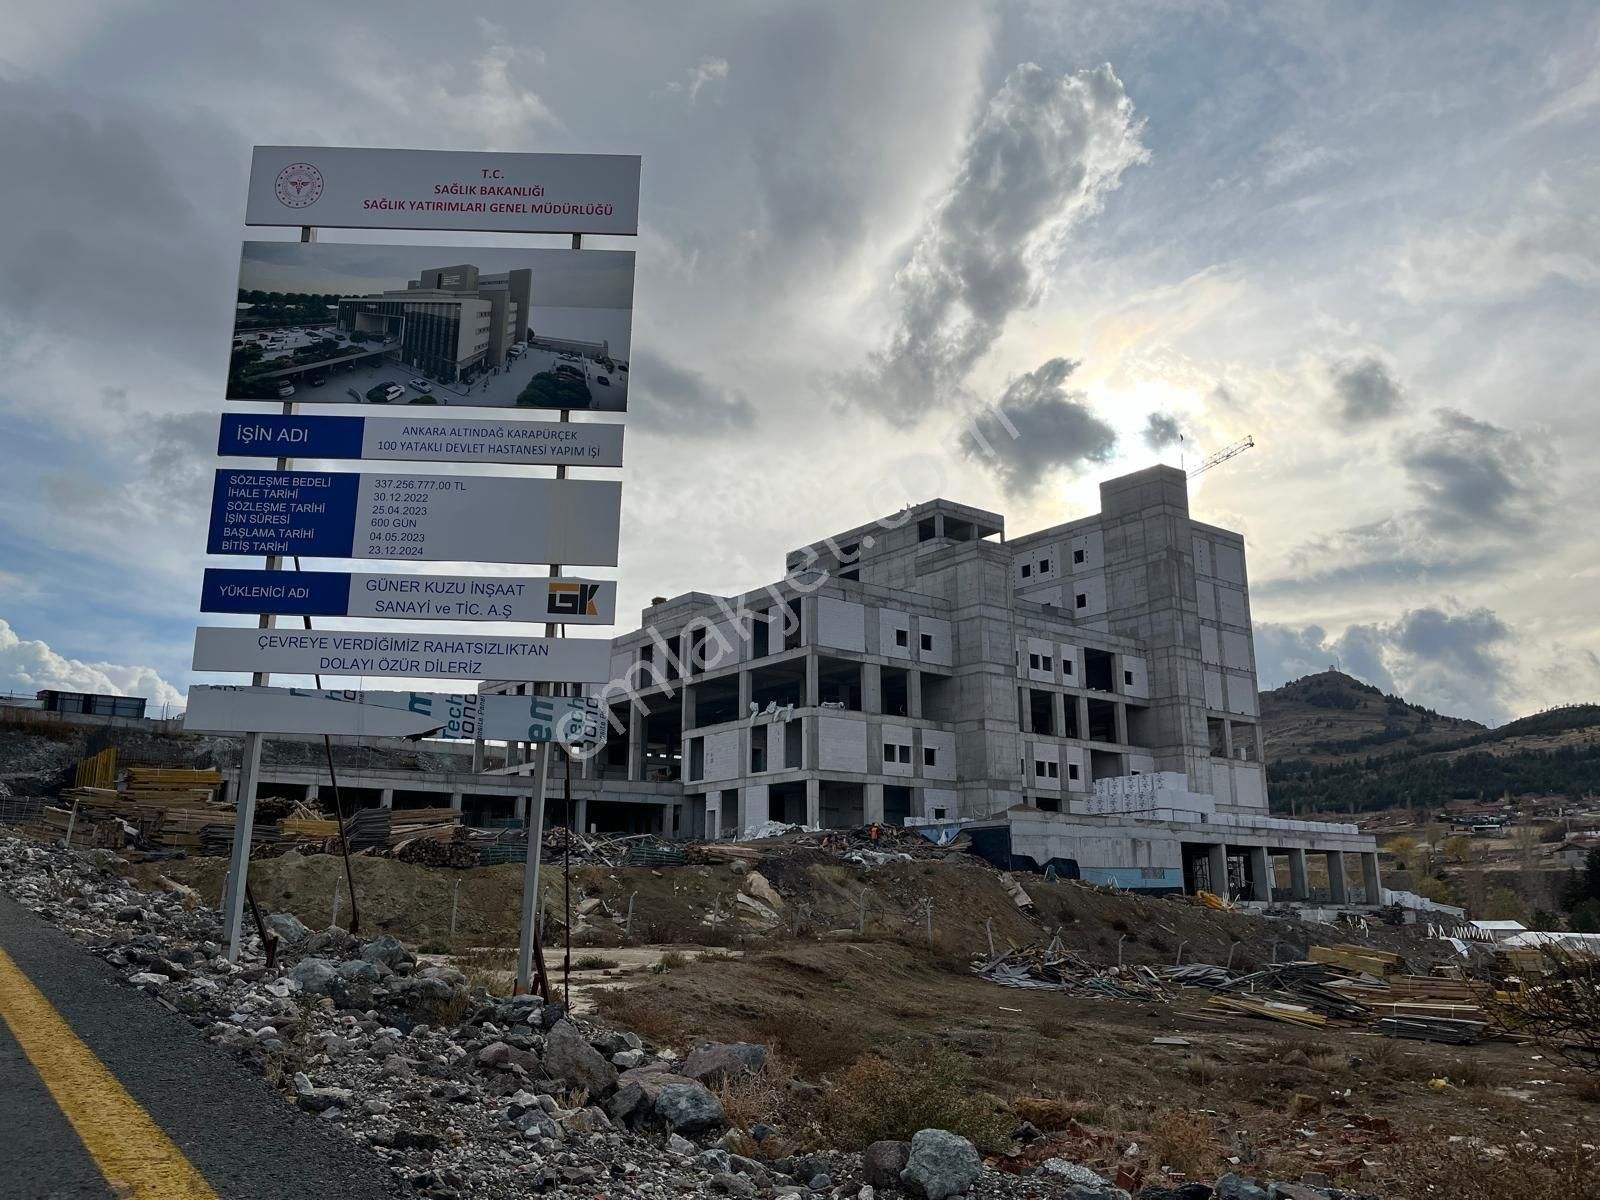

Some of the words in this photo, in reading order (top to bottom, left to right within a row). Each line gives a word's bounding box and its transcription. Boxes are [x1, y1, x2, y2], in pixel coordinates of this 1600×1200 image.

[482, 169, 504, 179] T.C.
[434, 183, 476, 196] SAĞLIK
[480, 185, 545, 197] BAKANLIĞI
[363, 198, 405, 211] SAĞLIK
[409, 201, 486, 212] YATIRIMLARI
[490, 202, 528, 214] GENEL
[531, 202, 613, 216] MÜDÜRLÜĞÜ
[237, 424, 272, 444] İŞİN
[277, 428, 308, 442] ADI
[402, 427, 446, 437] ANKARA
[450, 426, 504, 439] ALTINDAĞ
[508, 428, 578, 442] KARAPÜRÇEK
[378, 441, 397, 451] 100
[400, 442, 442, 452] YATAKLI
[446, 443, 484, 454] DEVLET
[550, 446, 584, 456] YAPIM
[230, 475, 290, 488] SÖZLEŞME
[292, 476, 331, 488] BEDELİ
[454, 482, 467, 490] TL
[228, 486, 259, 498] İHALE
[263, 488, 298, 499] TARİHİ
[374, 492, 428, 502] 30.12.2022
[226, 501, 286, 514] SÖZLEŞME
[290, 502, 326, 513] TARİHİ
[372, 506, 427, 516] 25.04.2023
[225, 512, 246, 524] İŞİN
[249, 513, 290, 524] SÜRESİ
[371, 518, 390, 528] 600
[392, 518, 416, 528] GÜN
[224, 527, 275, 538] BAŞLAMA
[278, 528, 314, 538] TARİHİ
[370, 532, 425, 542] 04.05.2023
[222, 540, 250, 552] BİTİŞ
[252, 541, 288, 552] TARİHİ
[368, 546, 423, 555] 23.12.2024
[220, 585, 285, 598] YÜKLENİCİ
[288, 588, 309, 598] ADI
[366, 578, 420, 593] GÜNER
[424, 582, 466, 594] KUZU
[470, 580, 525, 597] İNŞAAT
[375, 600, 430, 614] SANAYİ
[435, 604, 450, 614] ve
[456, 602, 482, 615] TİC.
[487, 604, 512, 619] A.Ş
[258, 635, 328, 650] ÇEVREYE
[333, 636, 419, 652] VERDİĞİMİZ
[424, 641, 549, 656] RAHATSIZLIKTAN
[319, 657, 374, 671] DOLAYI
[378, 658, 419, 672] ÖZÜR
[424, 659, 482, 674] DİLERİZ
